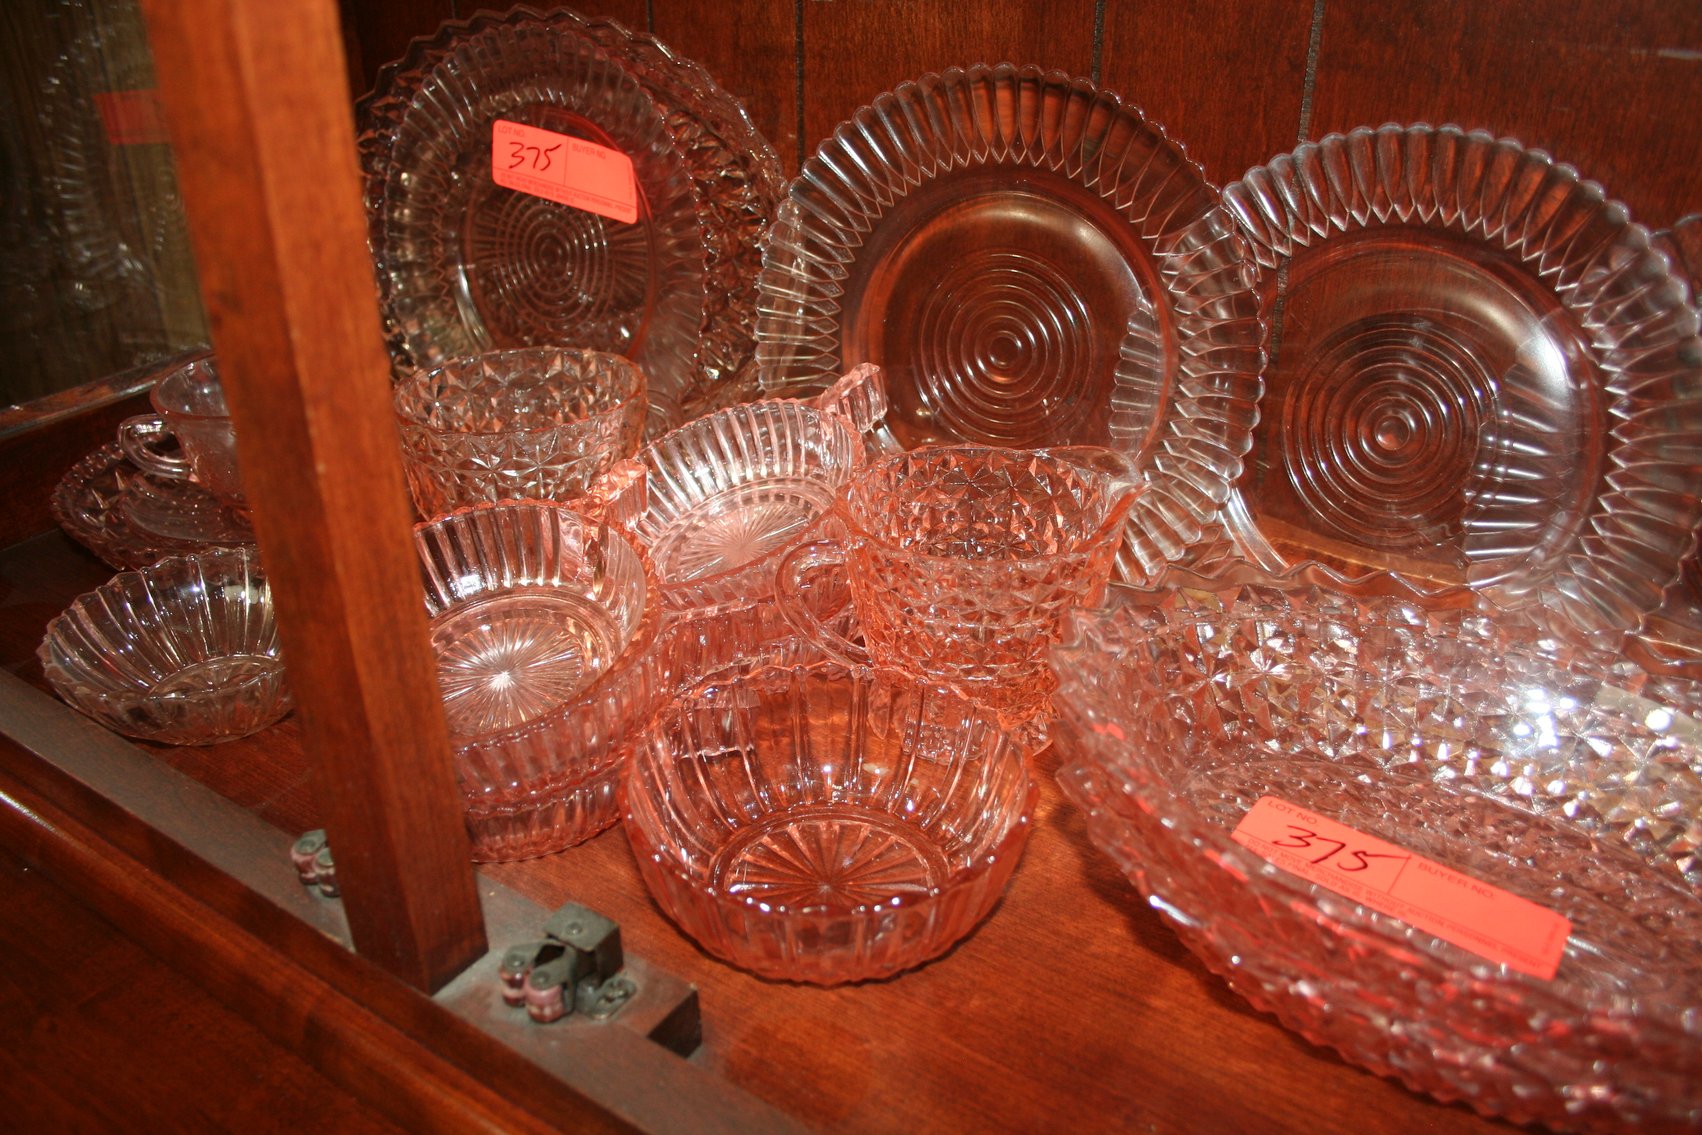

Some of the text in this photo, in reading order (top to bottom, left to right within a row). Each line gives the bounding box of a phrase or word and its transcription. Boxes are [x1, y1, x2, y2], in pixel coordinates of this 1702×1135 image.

[498, 126, 513, 136] LOT
[509, 142, 562, 171] 375
[572, 143, 596, 156] BUYER
[1268, 801, 1296, 815] LOT
[1272, 825, 1410, 871] 375
[1418, 862, 1468, 887] BUYER
